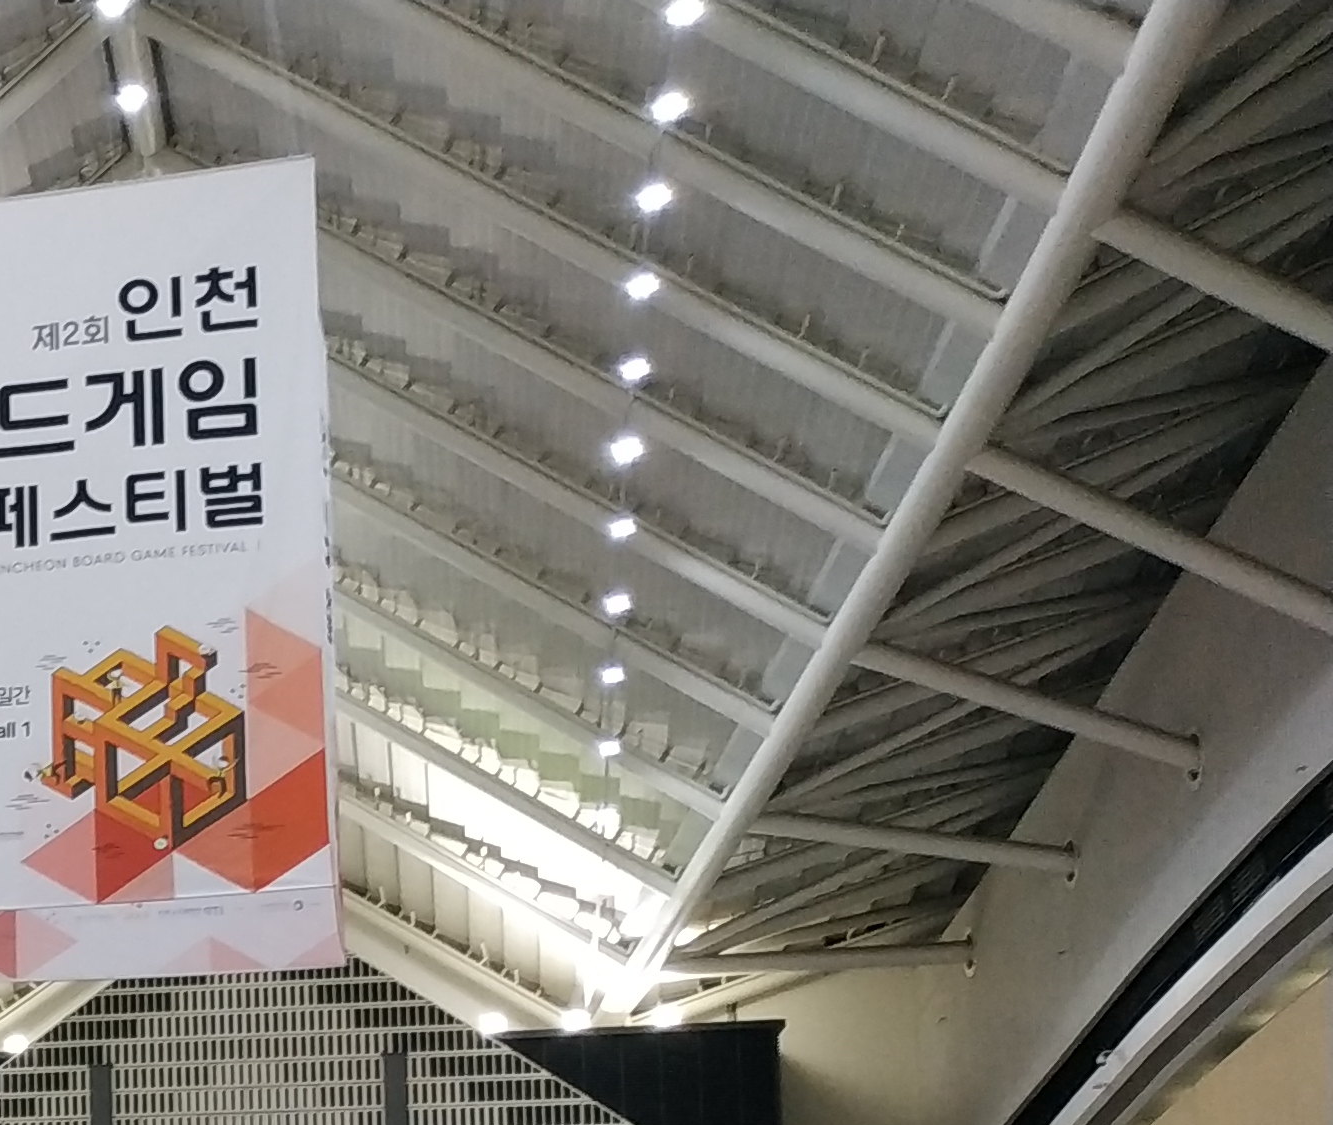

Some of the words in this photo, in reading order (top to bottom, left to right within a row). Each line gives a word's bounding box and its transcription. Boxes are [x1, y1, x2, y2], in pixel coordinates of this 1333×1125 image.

[32, 314, 111, 352] 제2회
[118, 265, 260, 343] 인천
[72, 551, 126, 567] BOARD
[131, 546, 175, 562] GAME
[181, 541, 247, 557] FESTIVAL
[21, 721, 31, 738] 1
